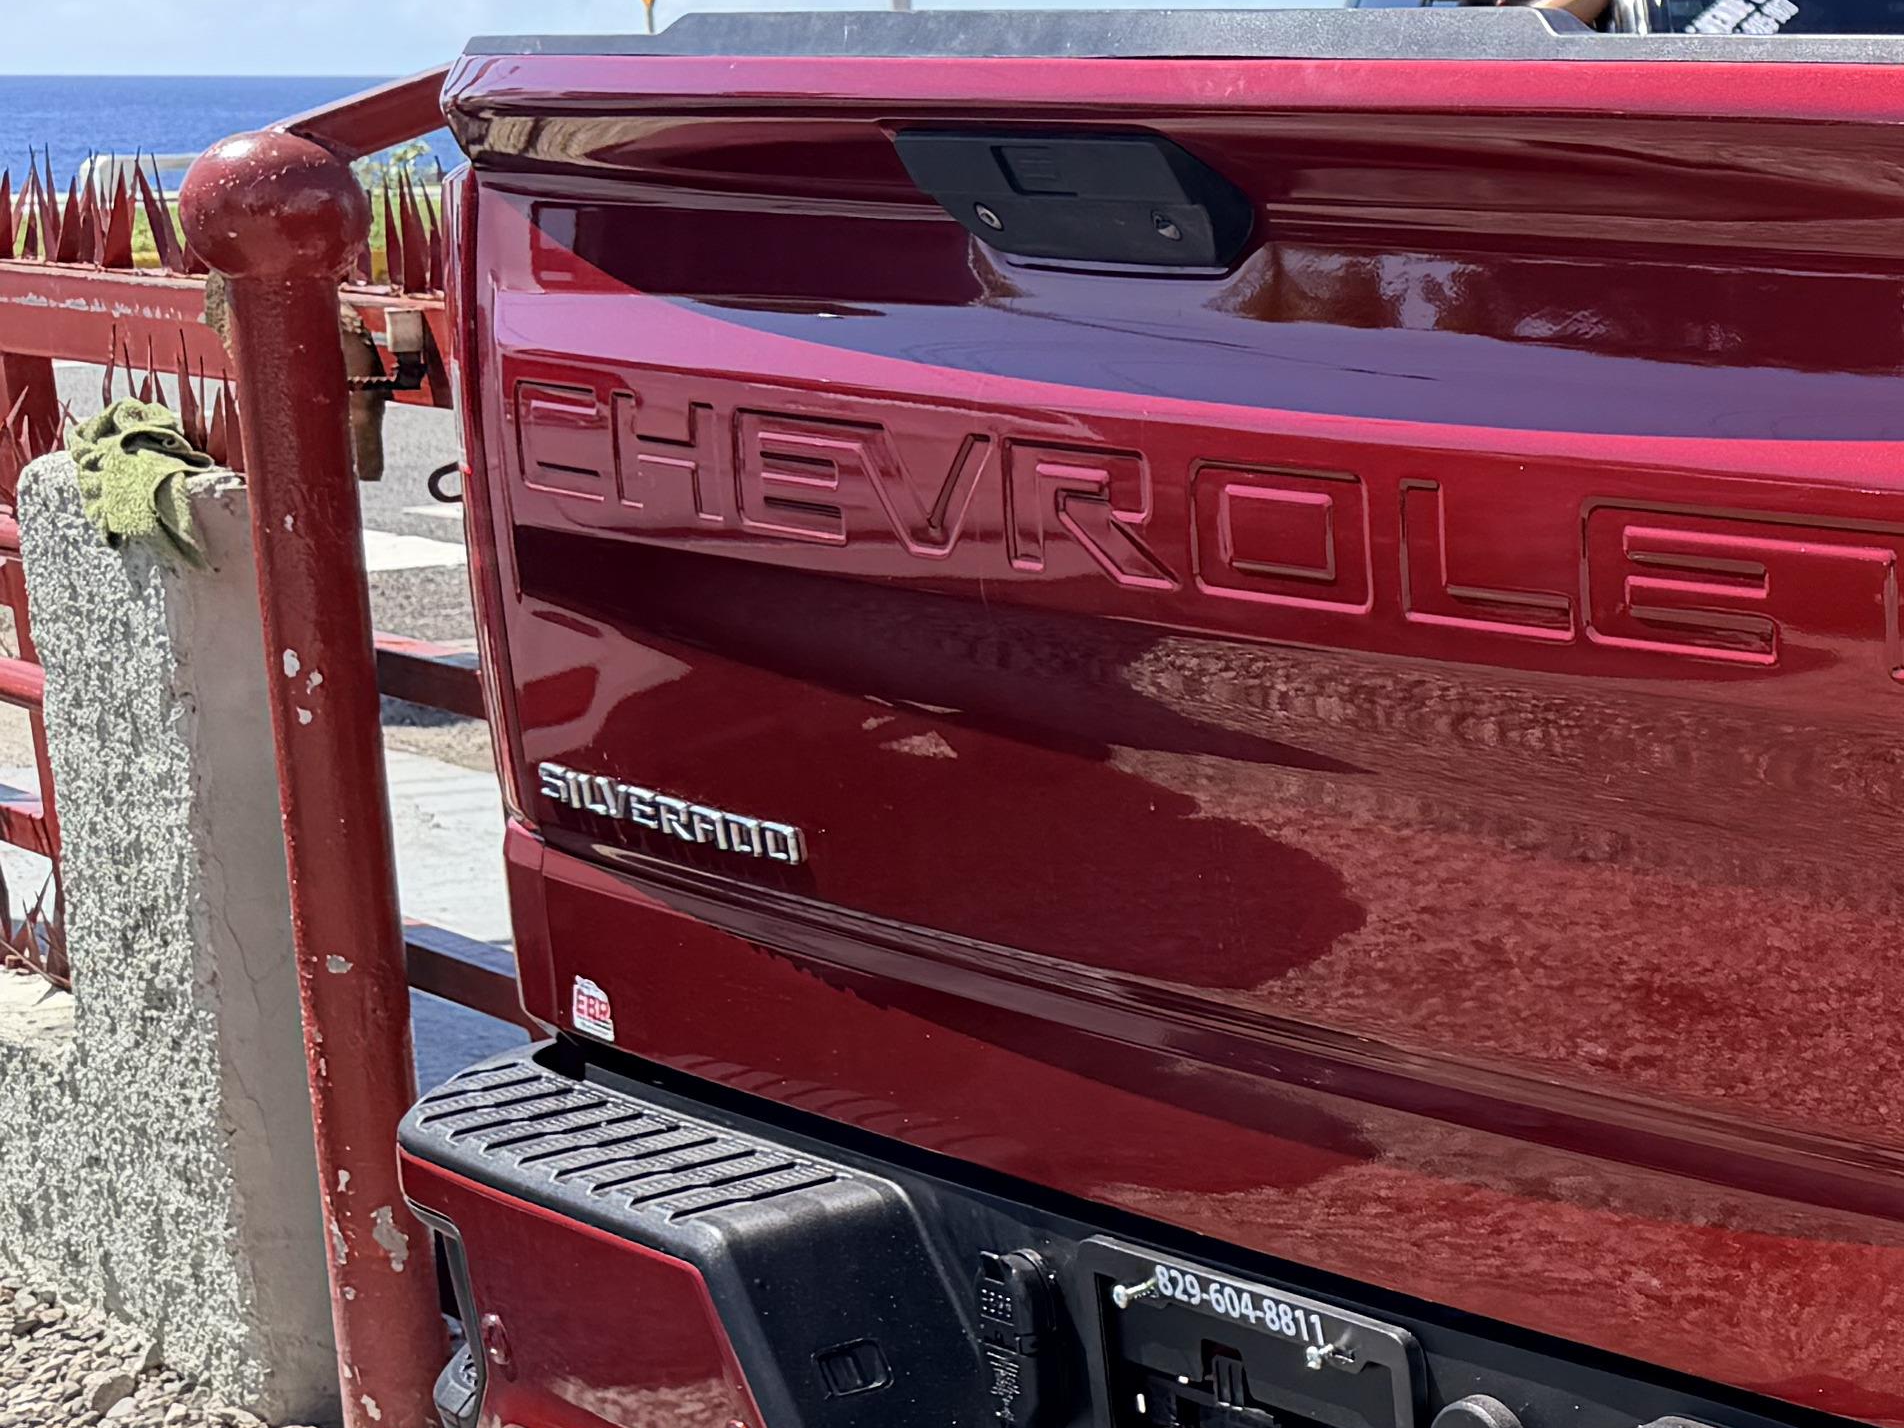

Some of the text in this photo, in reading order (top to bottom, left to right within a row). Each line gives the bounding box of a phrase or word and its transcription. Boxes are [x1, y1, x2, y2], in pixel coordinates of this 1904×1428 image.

[538, 761, 809, 865] SILVERADO
[576, 988, 611, 1021] EBR
[1155, 1264, 1325, 1346] 829-604-8811
